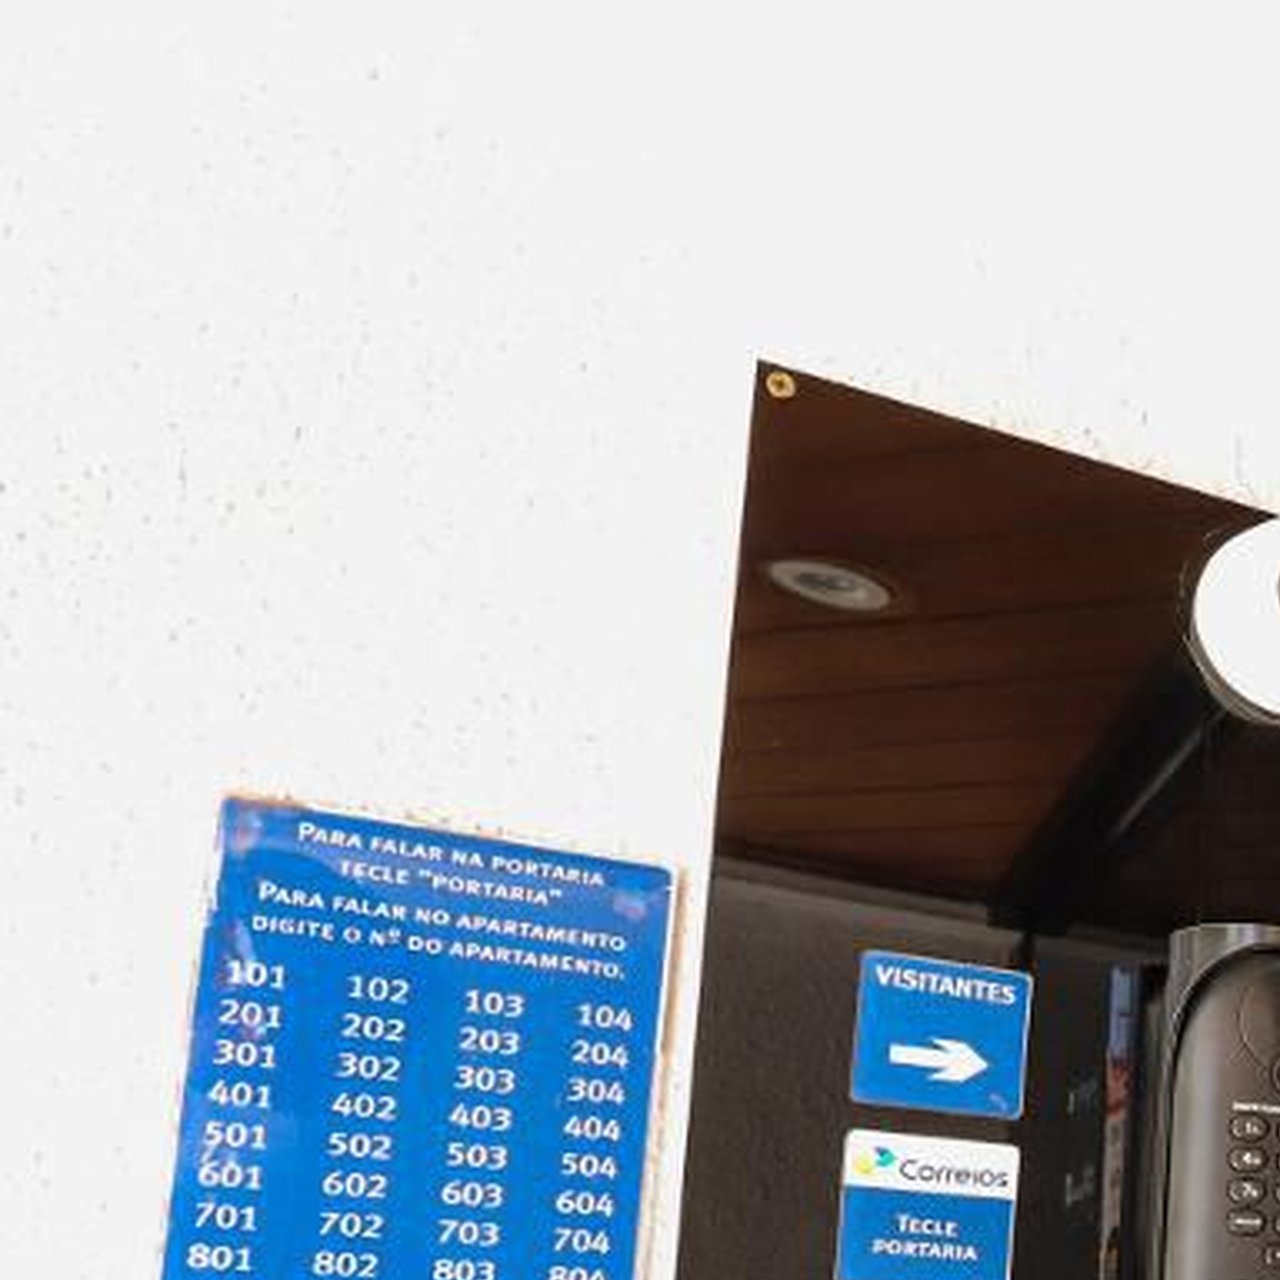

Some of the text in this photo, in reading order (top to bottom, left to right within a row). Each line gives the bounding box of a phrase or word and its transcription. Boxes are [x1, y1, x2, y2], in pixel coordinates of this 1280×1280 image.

[299, 823, 604, 886] PARA FALAR NA PORTARIA
[340, 861, 409, 885] TECLE
[252, 915, 334, 941] DIGITE
[343, 926, 361, 944] O
[408, 936, 443, 954] DO
[259, 882, 627, 951] PARA FALAR NO APARTAMENTO
[222, 961, 633, 1031] 101 102 103 104
[876, 964, 1016, 1005] VISITANTES
[218, 1000, 630, 1068] 201 202 203 204
[212, 1040, 626, 1105] 301 302 303 304
[207, 1081, 621, 1142] 401 402 403 404
[203, 1122, 618, 1179] 501 502 503 504
[900, 1159, 1008, 1188] Correios
[197, 1163, 614, 1217] 601 602 603 604
[193, 1203, 610, 1255] 701 702 703 704
[872, 1238, 978, 1261] PORTARIA
[898, 1215, 958, 1238] TECLE
[186, 1244, 251, 1271] 801
[313, 1252, 379, 1278] 802
